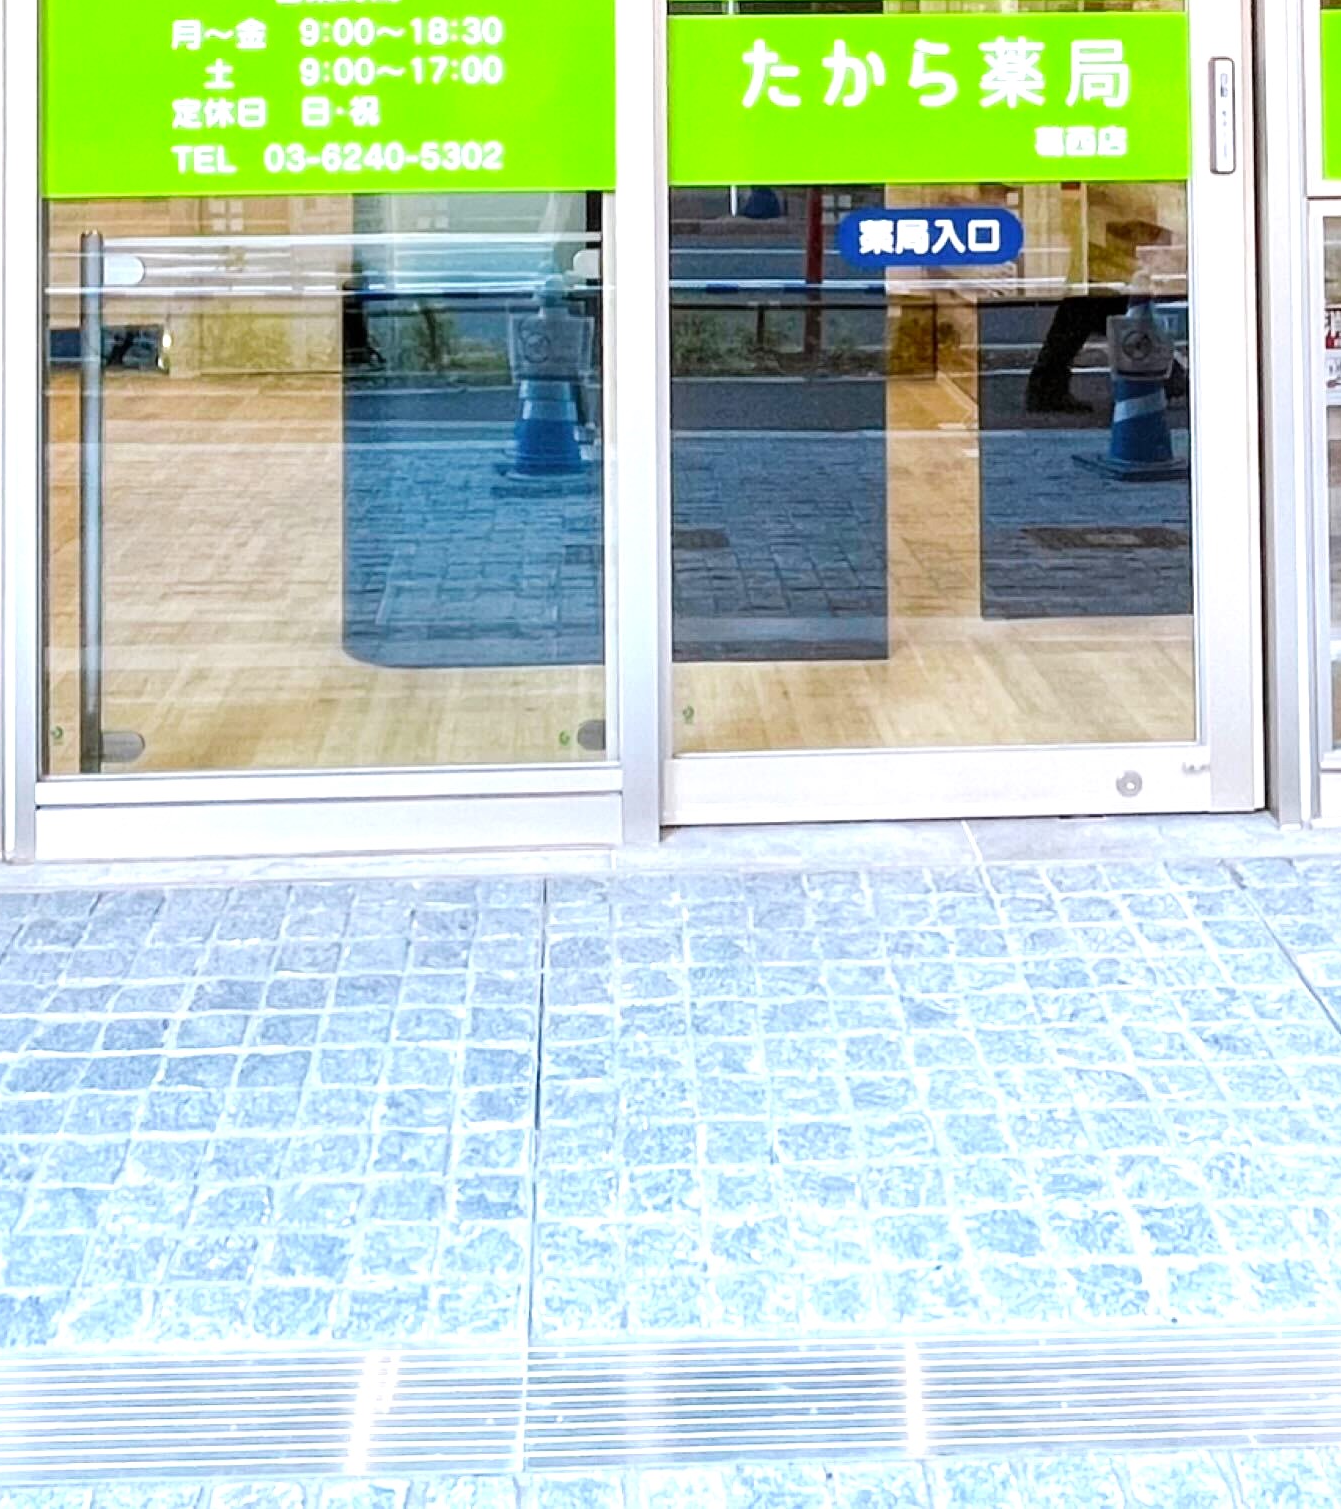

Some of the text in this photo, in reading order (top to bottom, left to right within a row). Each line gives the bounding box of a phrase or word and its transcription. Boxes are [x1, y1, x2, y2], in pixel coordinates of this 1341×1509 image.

[205, 58, 234, 90] 土
[742, 37, 1130, 109] たから薬局
[171, 98, 267, 129] 定休日
[171, 140, 504, 174] TEL 03-6240-5302
[858, 220, 1001, 254] 薬局入口
